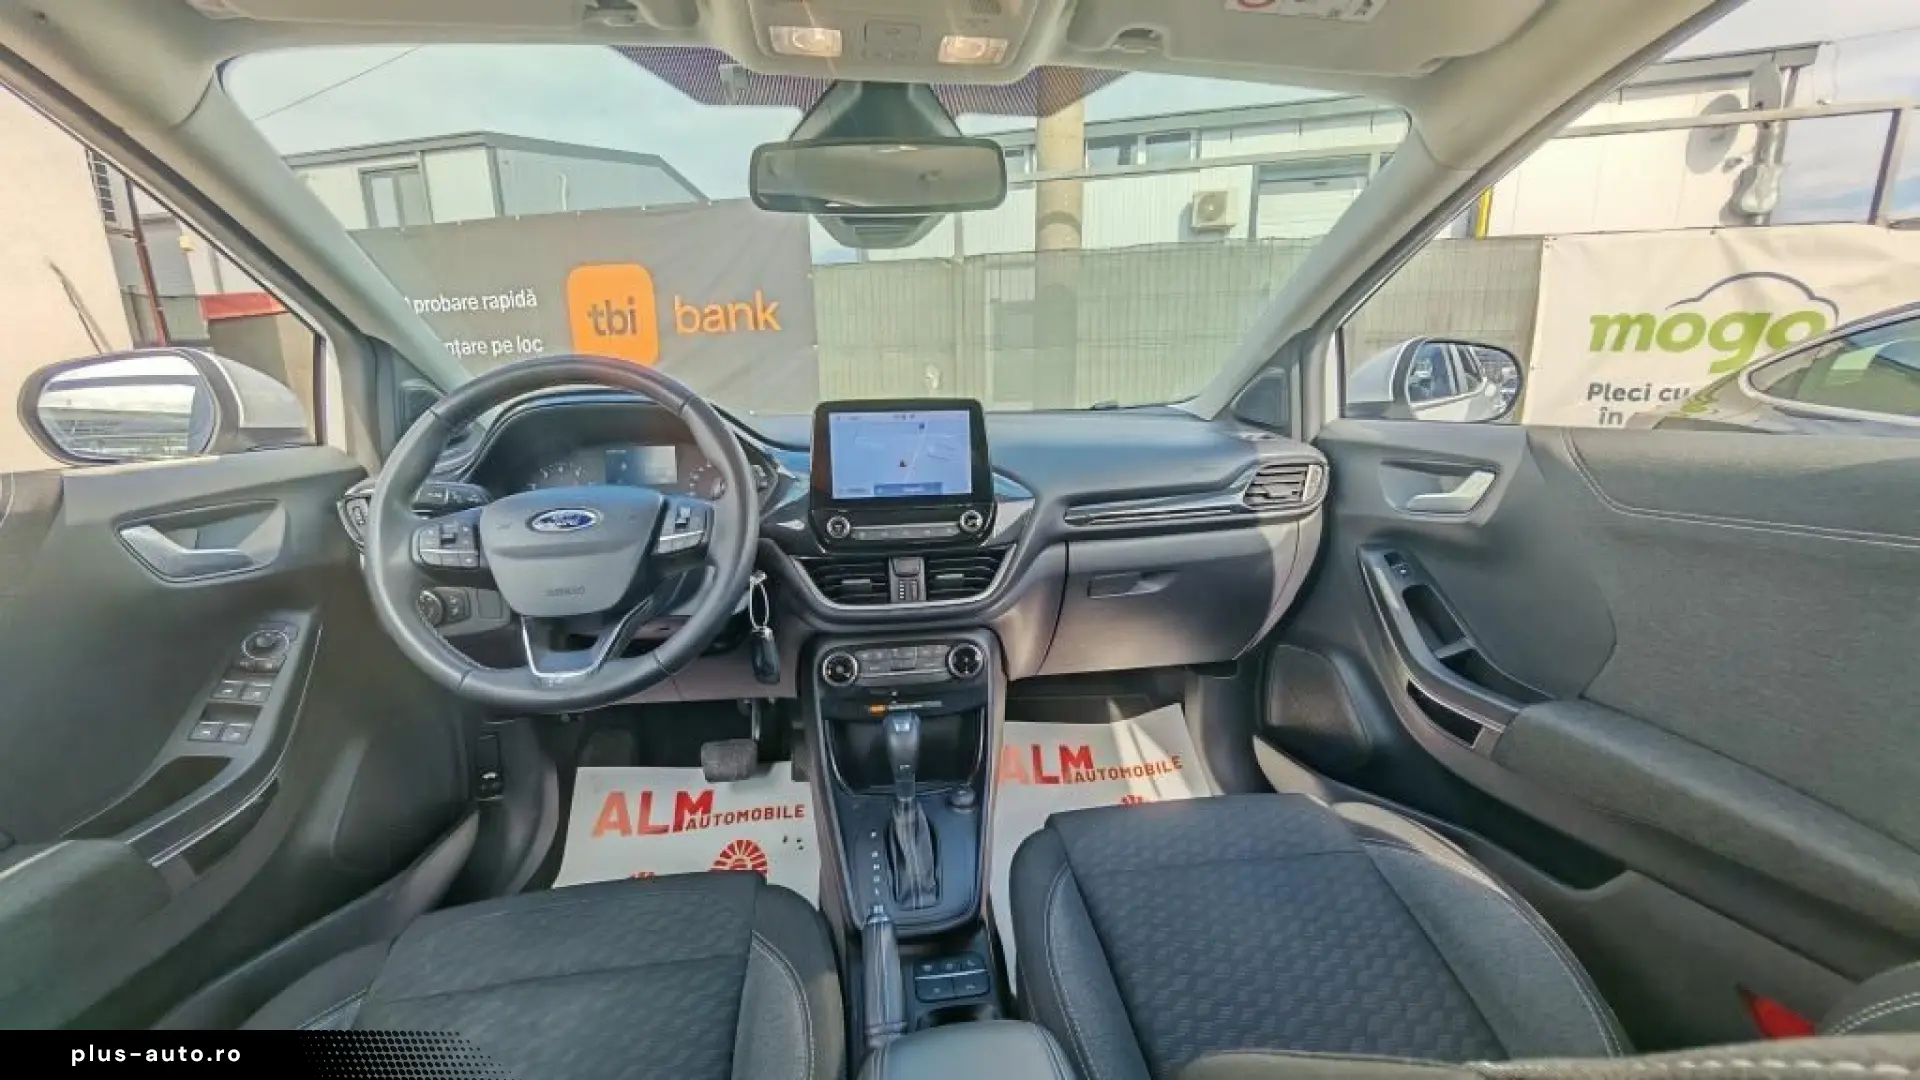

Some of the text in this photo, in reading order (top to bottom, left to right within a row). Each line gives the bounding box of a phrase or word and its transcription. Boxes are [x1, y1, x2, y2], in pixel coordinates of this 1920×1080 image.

[404, 287, 538, 315] probare rapidă
[587, 290, 781, 336] tbi bank
[443, 335, 544, 358] nțare pe loc
[1590, 310, 1826, 374] mogo
[1587, 382, 1652, 401] Pleci
[1598, 406, 1623, 425] în
[998, 743, 1183, 785] ALM AUTOMOBILE
[591, 788, 805, 837] ALM AUTOMOBILE
